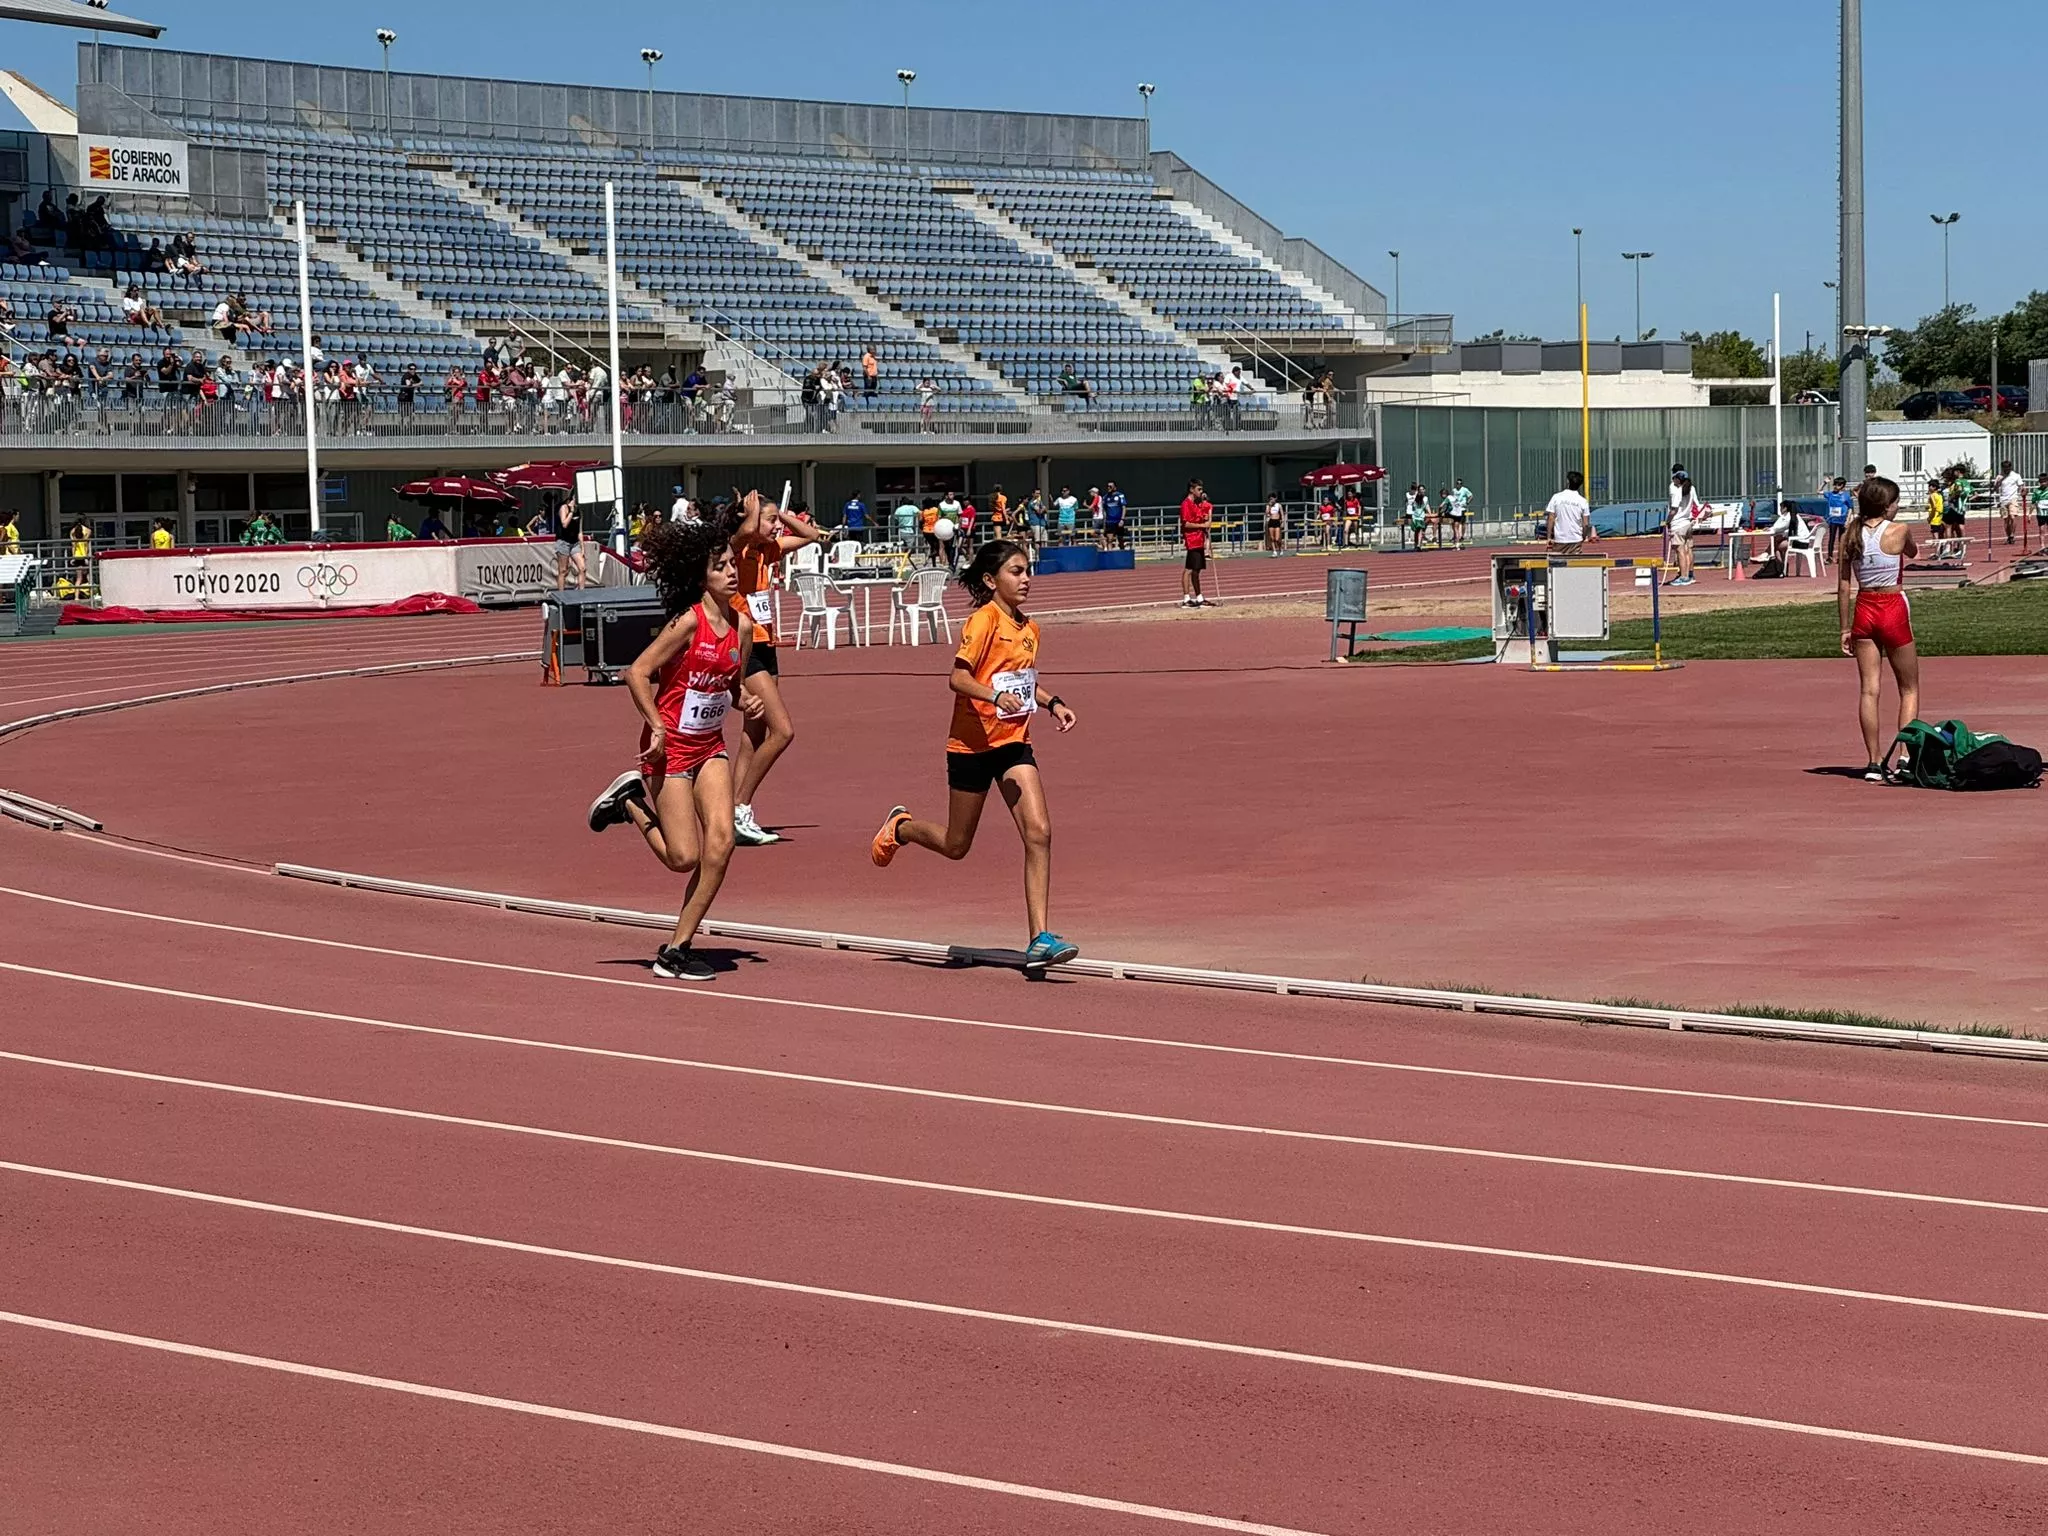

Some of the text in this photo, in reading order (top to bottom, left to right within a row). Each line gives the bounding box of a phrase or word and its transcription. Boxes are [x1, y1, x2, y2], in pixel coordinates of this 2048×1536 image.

[112, 149, 172, 167] GOBIERNO
[112, 166, 180, 185] DE ARAGON
[477, 563, 543, 584] TOKYO 2020
[174, 573, 280, 594] TOKYO 2020
[755, 599, 771, 613] 16
[691, 705, 725, 719] 1666
